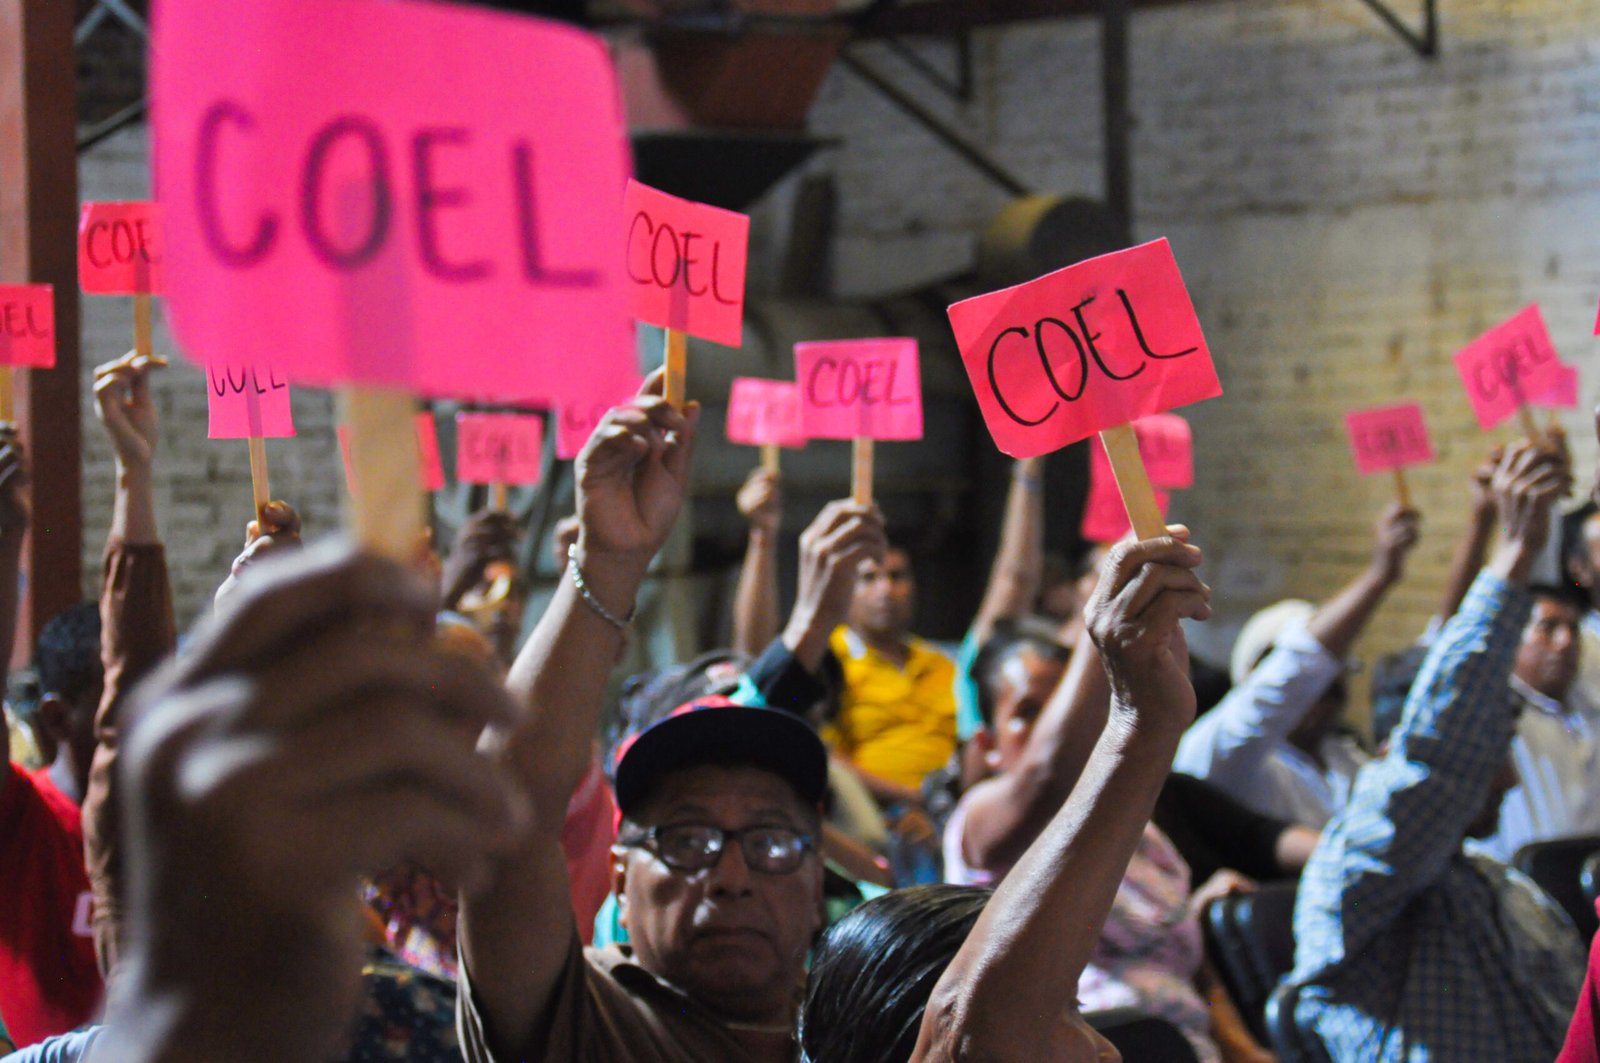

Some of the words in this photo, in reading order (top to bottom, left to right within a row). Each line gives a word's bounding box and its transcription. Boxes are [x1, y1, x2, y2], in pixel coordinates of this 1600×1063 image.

[196, 99, 602, 289] COEL
[85, 218, 161, 269] COE
[626, 210, 737, 305] COEL
[808, 356, 912, 408] COEL
[988, 288, 1198, 427] COEL
